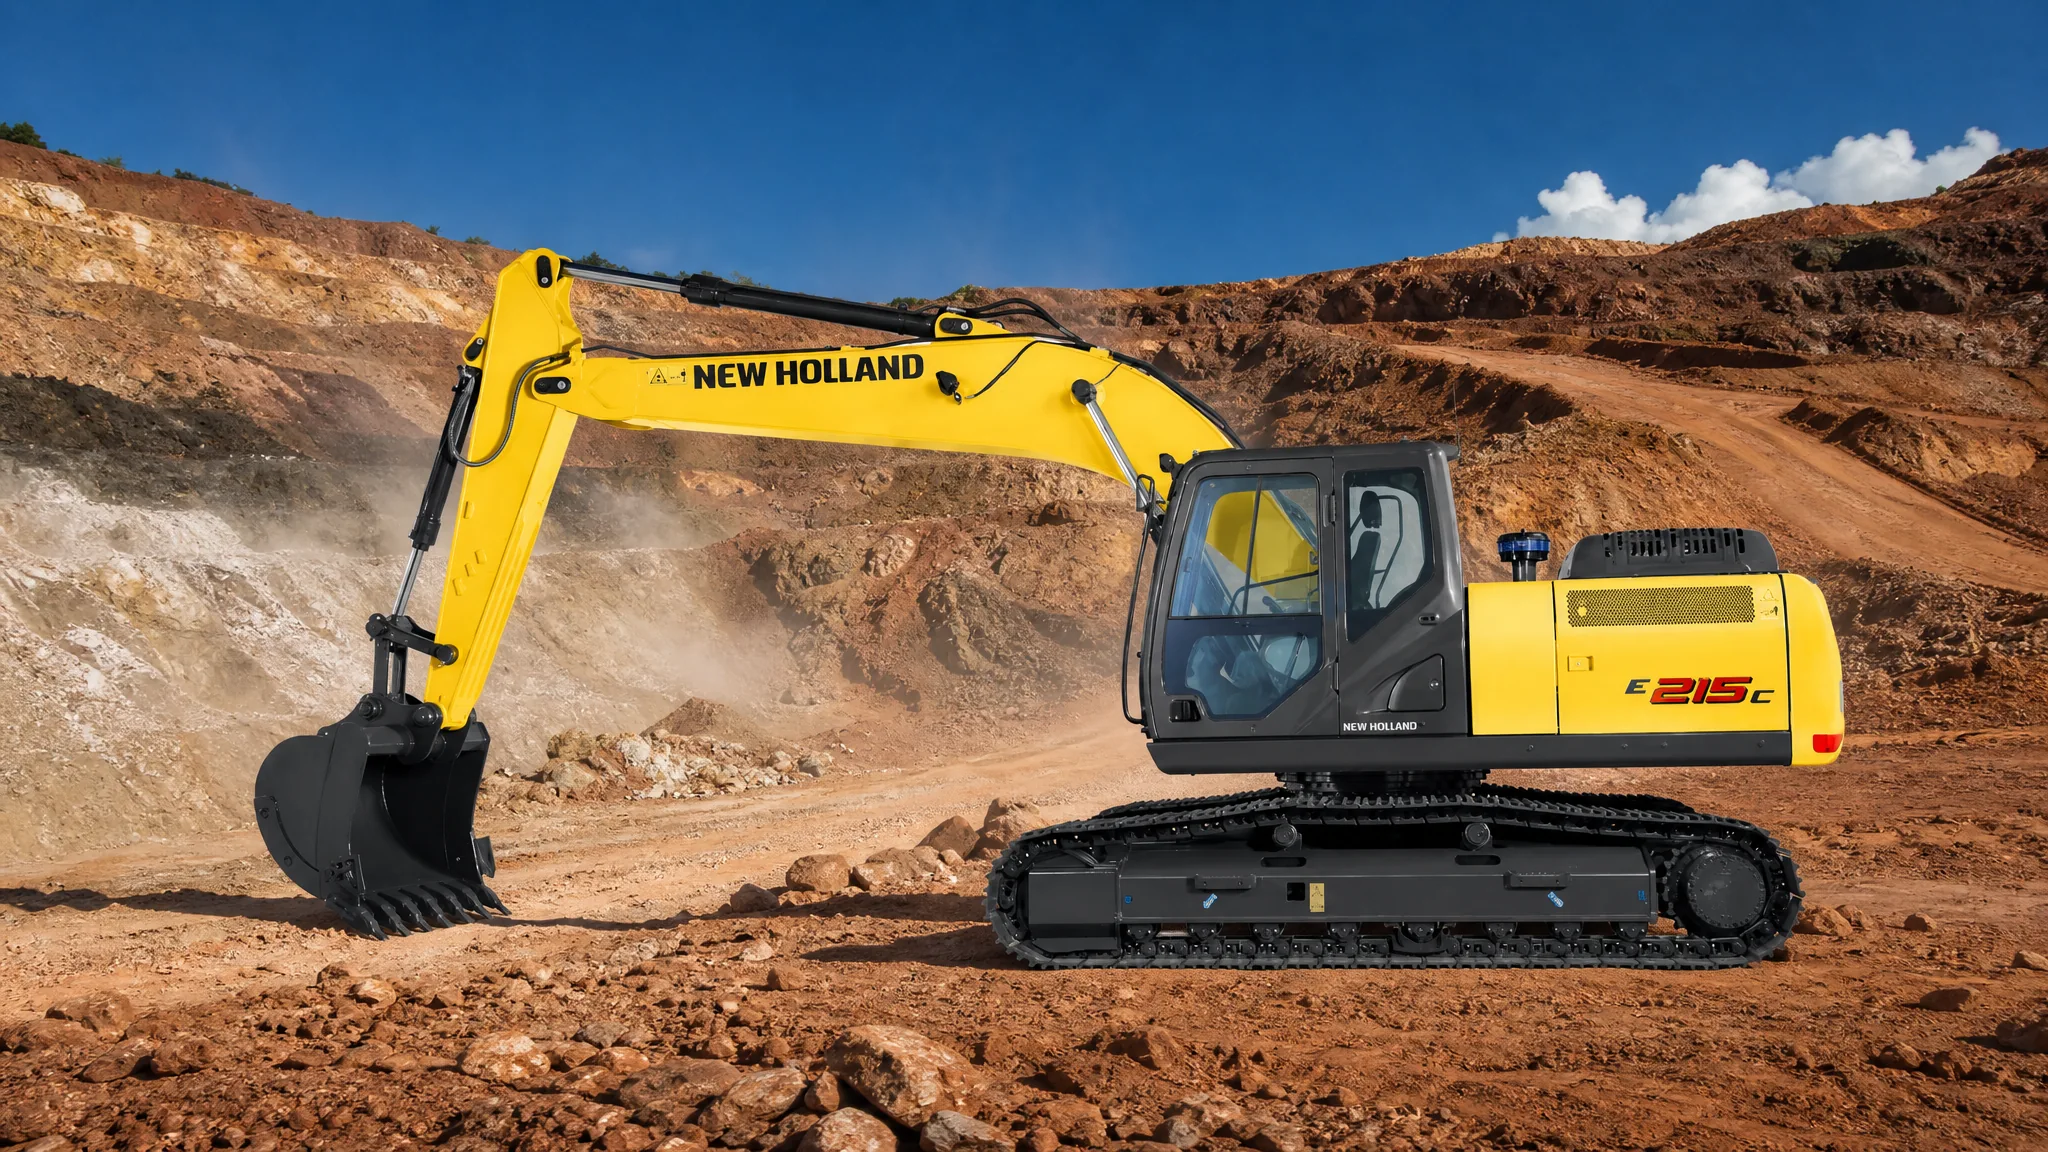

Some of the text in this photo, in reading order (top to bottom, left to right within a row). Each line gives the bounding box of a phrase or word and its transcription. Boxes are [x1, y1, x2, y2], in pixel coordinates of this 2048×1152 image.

[693, 353, 924, 389] NEW HOLLAND
[1343, 721, 1418, 731] NEW HOLLAND
